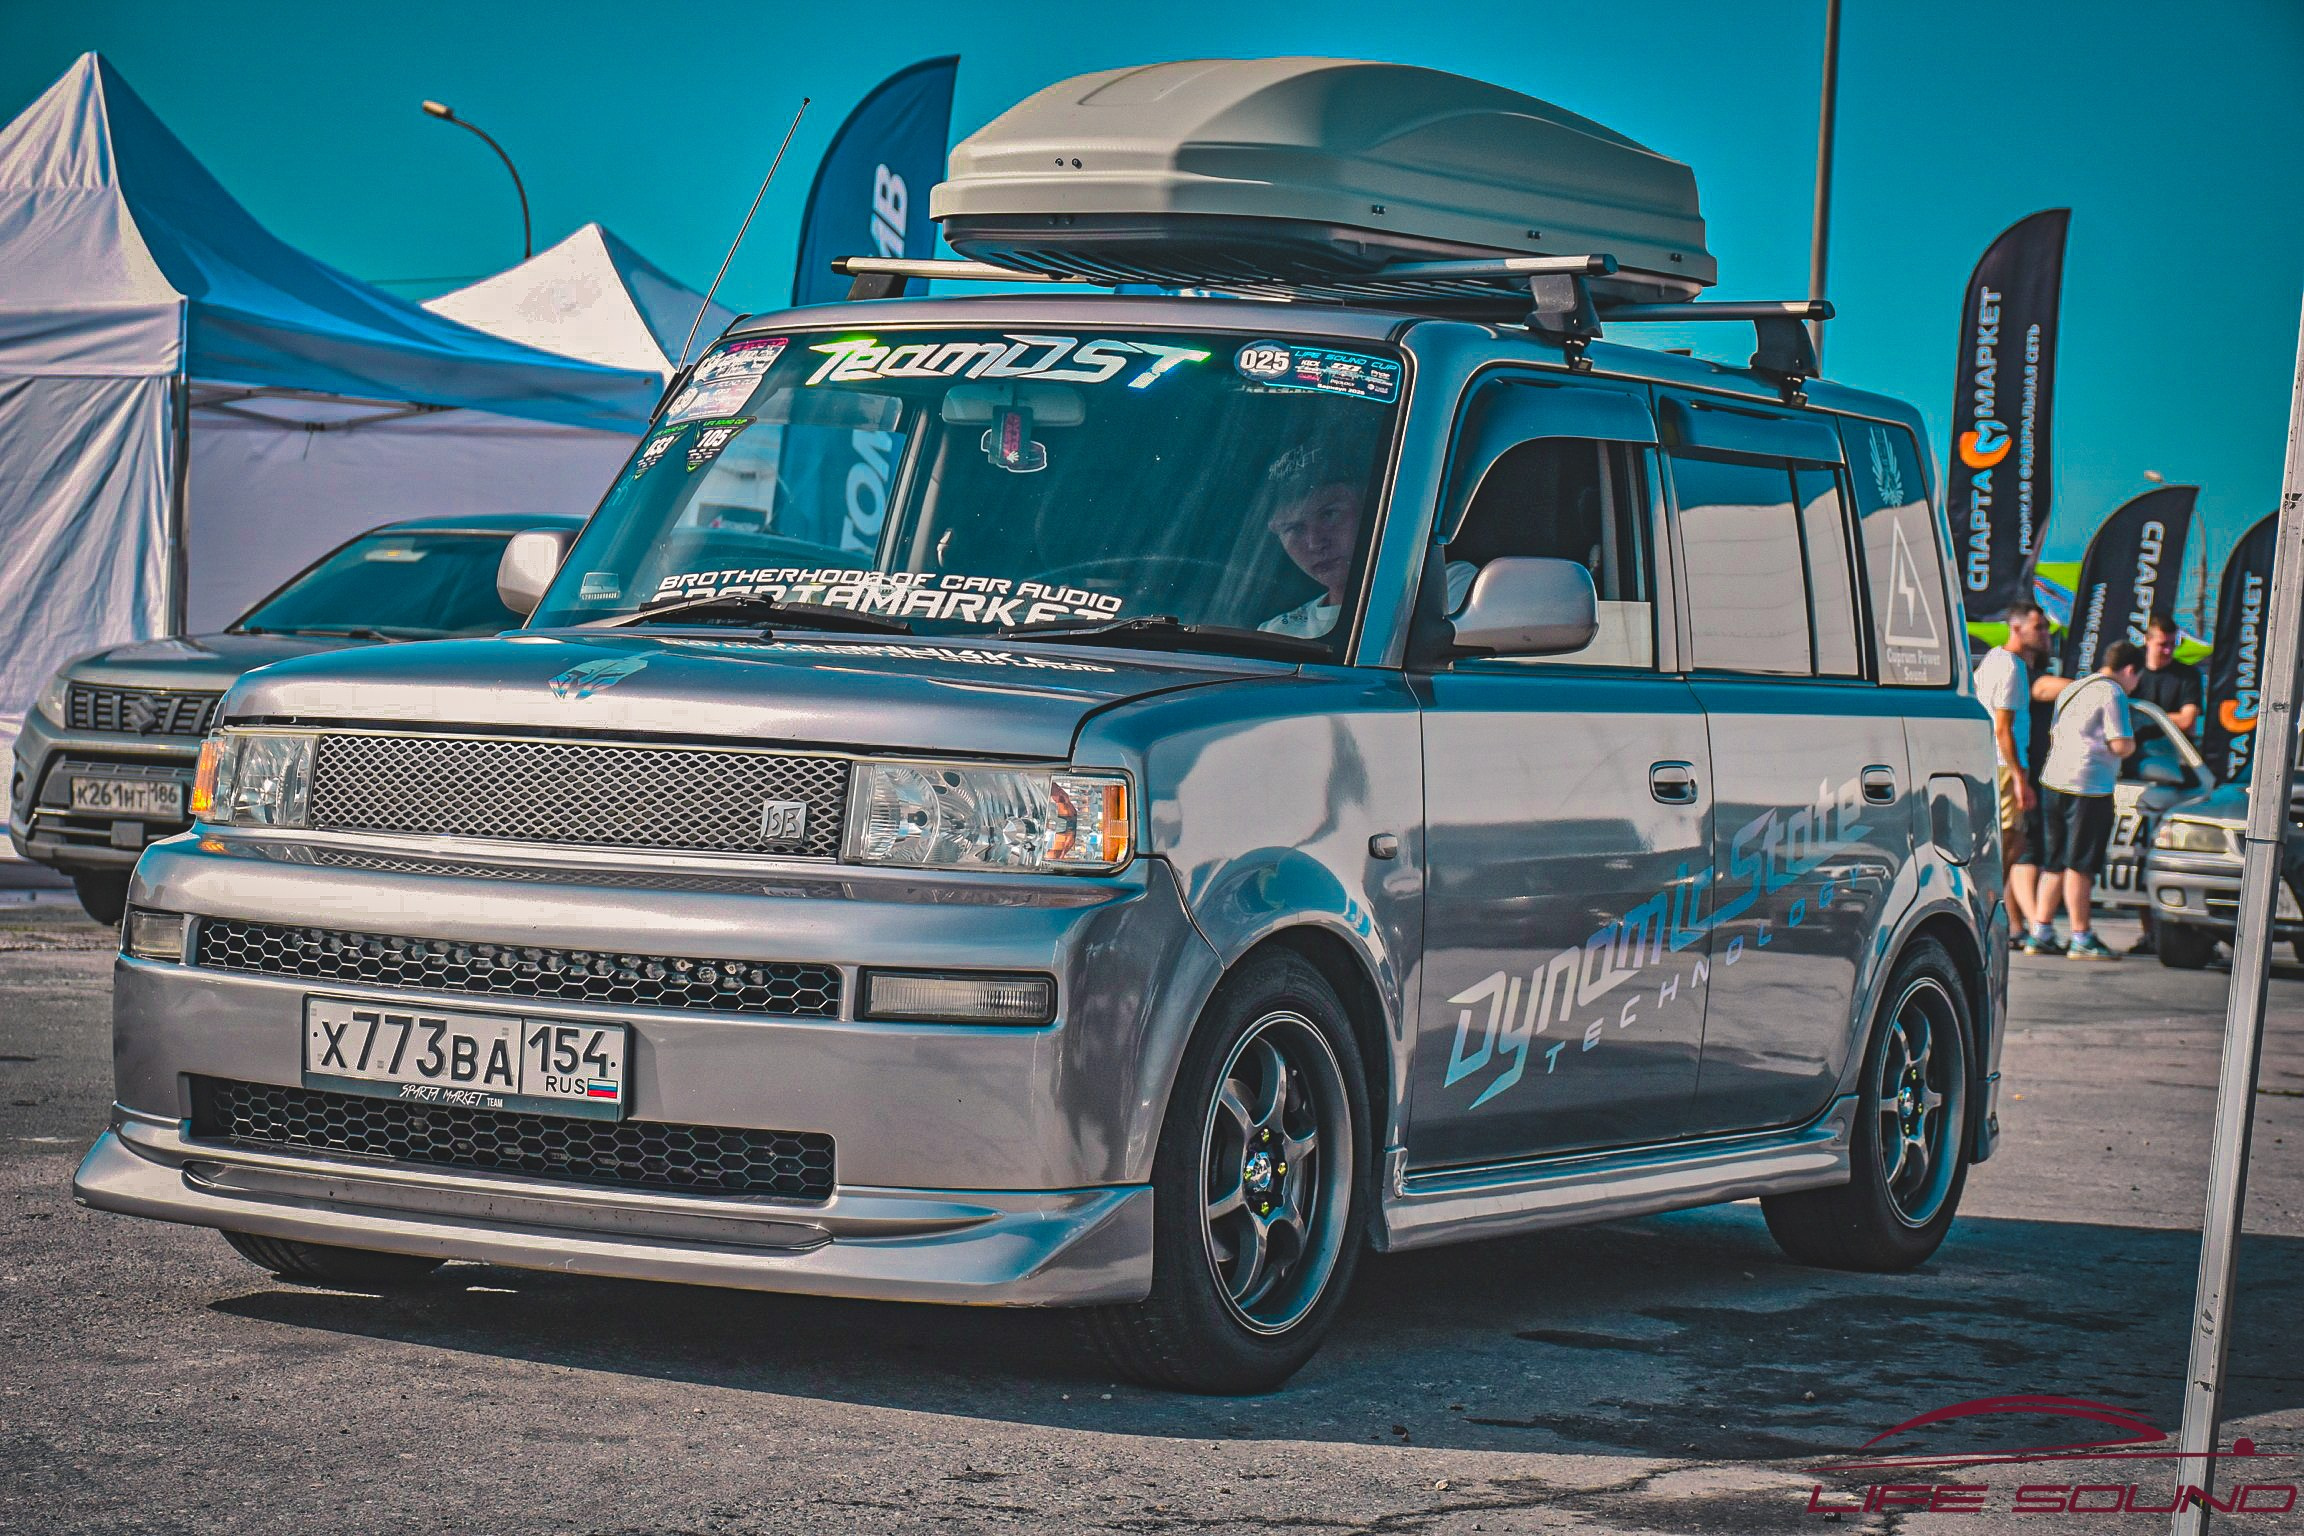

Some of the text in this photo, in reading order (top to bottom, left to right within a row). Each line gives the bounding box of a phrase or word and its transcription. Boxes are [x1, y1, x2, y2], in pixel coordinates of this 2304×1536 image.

[1240, 350, 1290, 371] 025
[1294, 350, 1321, 358] LIFE
[1325, 353, 1367, 365] SOUND
[1371, 361, 1397, 370] CUP
[697, 429, 732, 447] 105
[1967, 286, 2001, 591] СПАРТА МАРКЕТ
[659, 568, 1122, 612] BROTHERHOOD OF CAR AUDIO
[2127, 521, 2165, 647] СПАРТА
[2236, 571, 2263, 687] МАРКЕТ
[1904, 666, 1927, 682] Sound
[1443, 777, 1875, 1110] Dynamic State
[1545, 861, 1861, 1073] TECHNOLOGY
[527, 1025, 608, 1078] 154
[400, 1083, 503, 1108] SPARTA MARKET TEAM
[546, 1076, 585, 1095] RUS
